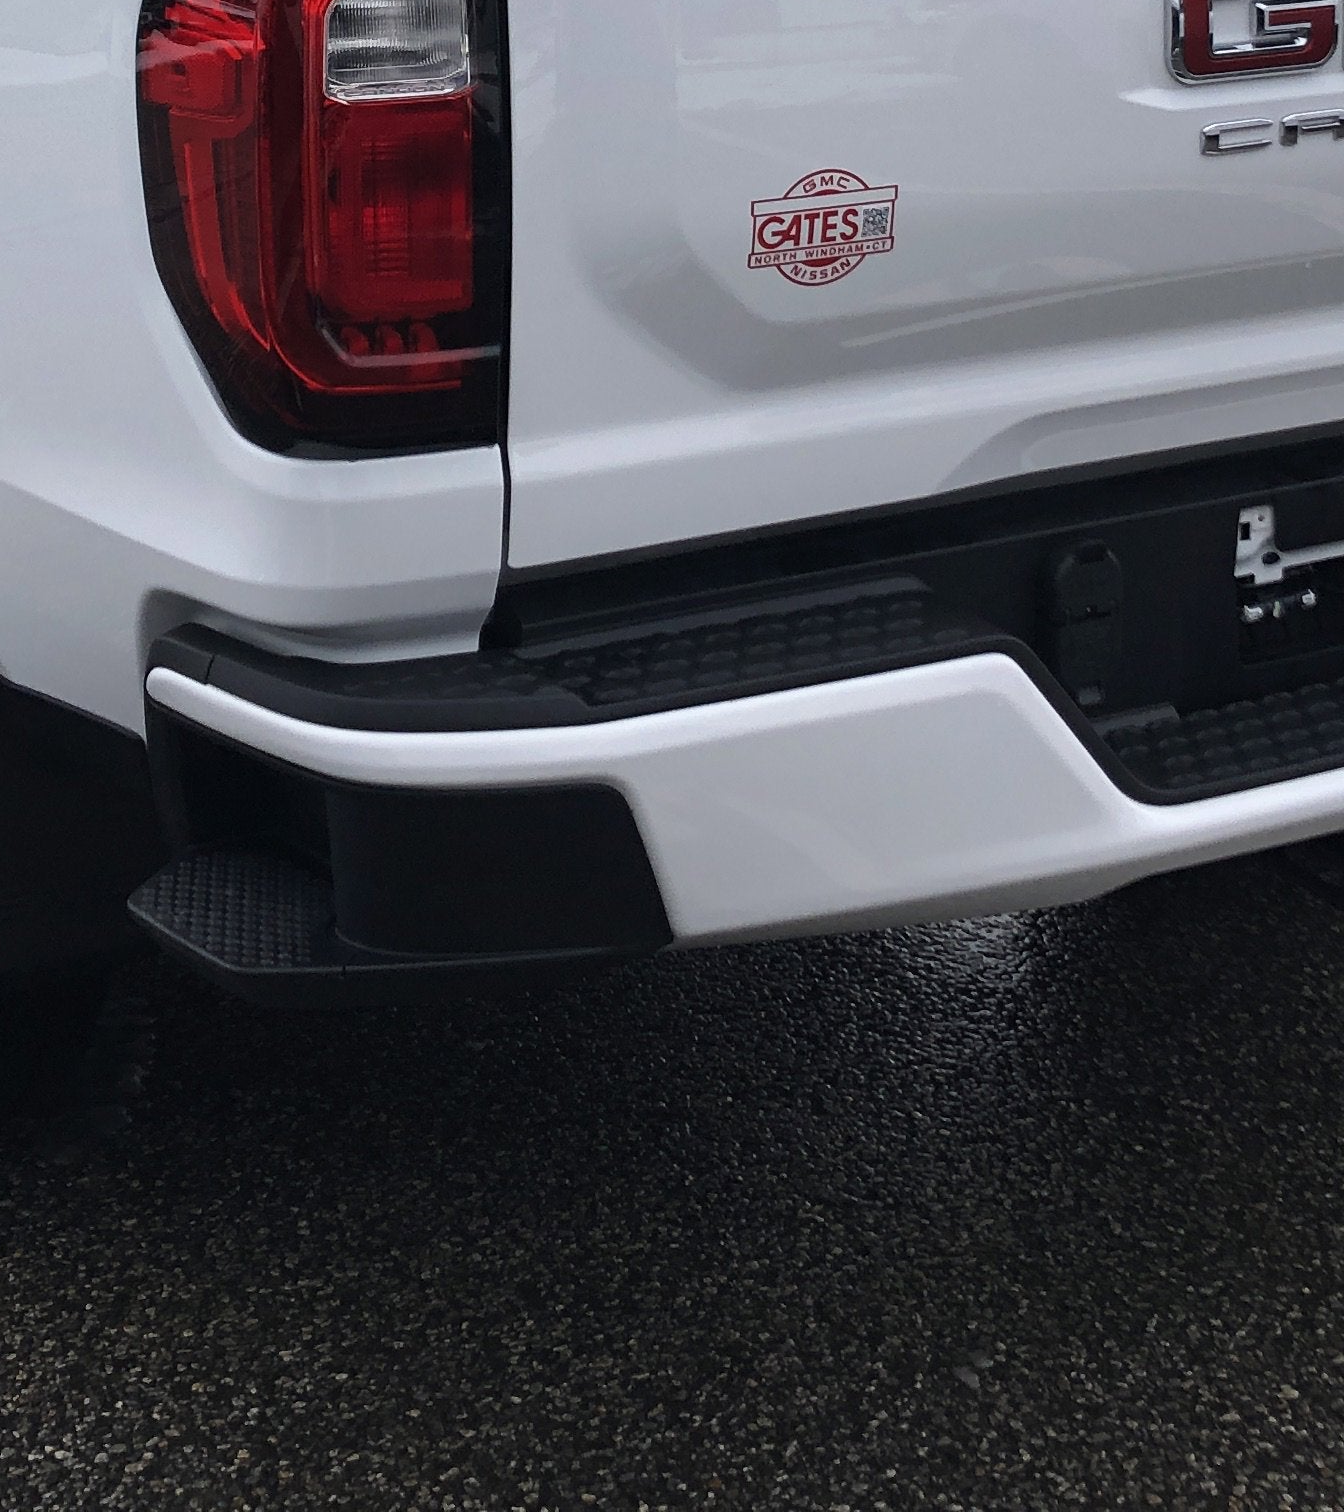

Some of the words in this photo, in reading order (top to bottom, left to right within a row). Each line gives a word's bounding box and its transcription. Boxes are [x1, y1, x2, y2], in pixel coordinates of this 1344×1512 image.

[802, 175, 850, 194] GMC
[757, 208, 859, 249] GATES
[754, 252, 797, 265] NORTH
[805, 243, 864, 259] WINDHAM
[790, 258, 851, 281] NISSAN
